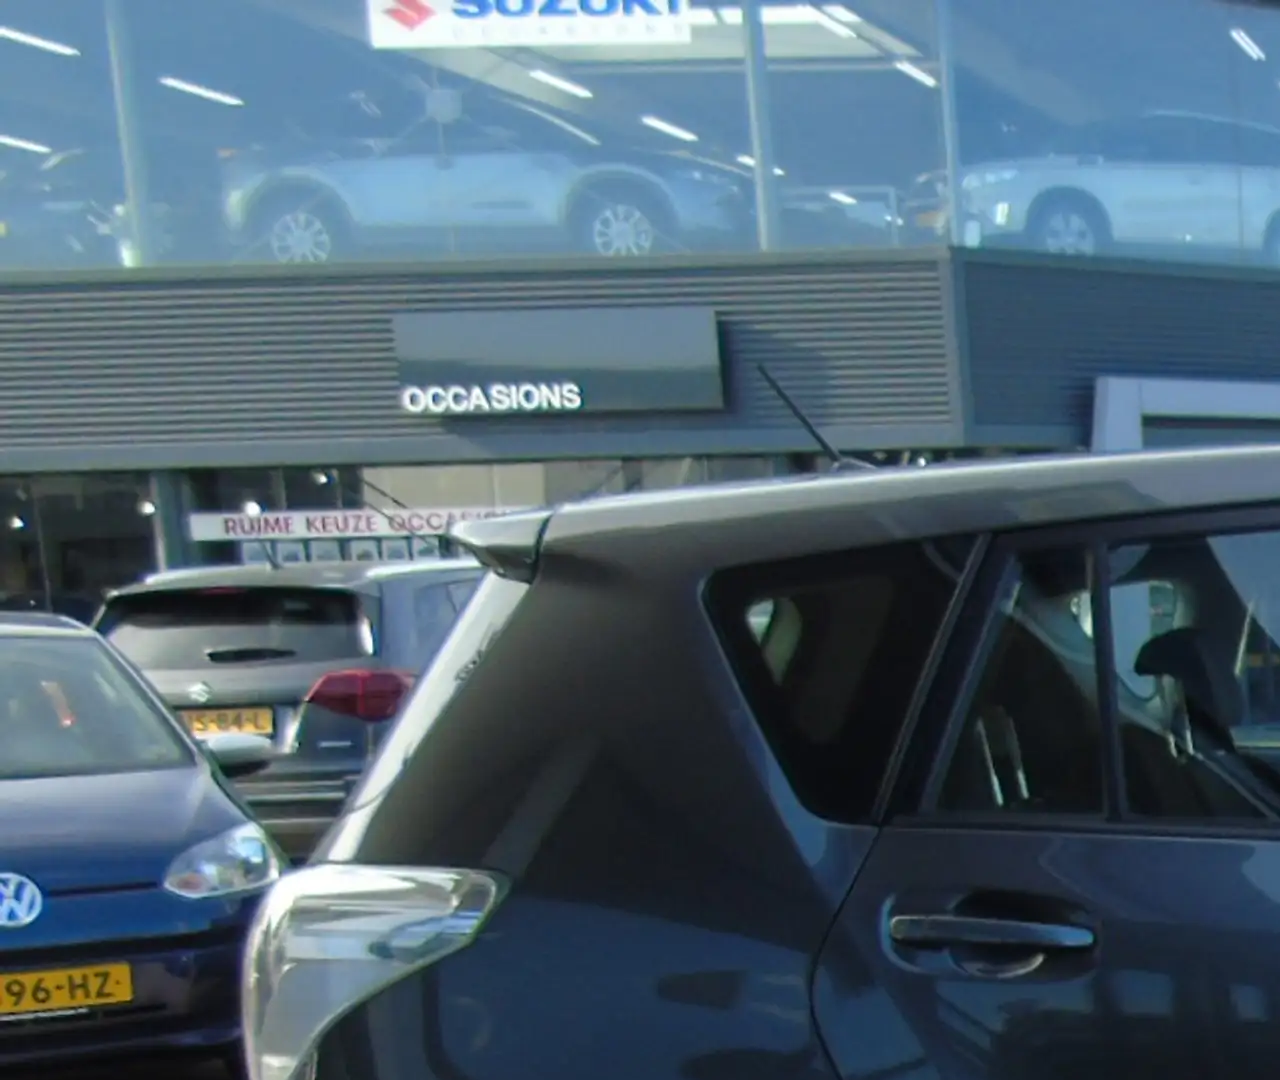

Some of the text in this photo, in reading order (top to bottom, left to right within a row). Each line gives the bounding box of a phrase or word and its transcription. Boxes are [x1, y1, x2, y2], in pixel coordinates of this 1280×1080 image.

[402, 383, 582, 412] OCCASIONS
[223, 512, 295, 536] RUIME
[306, 513, 377, 534] KEUZE
